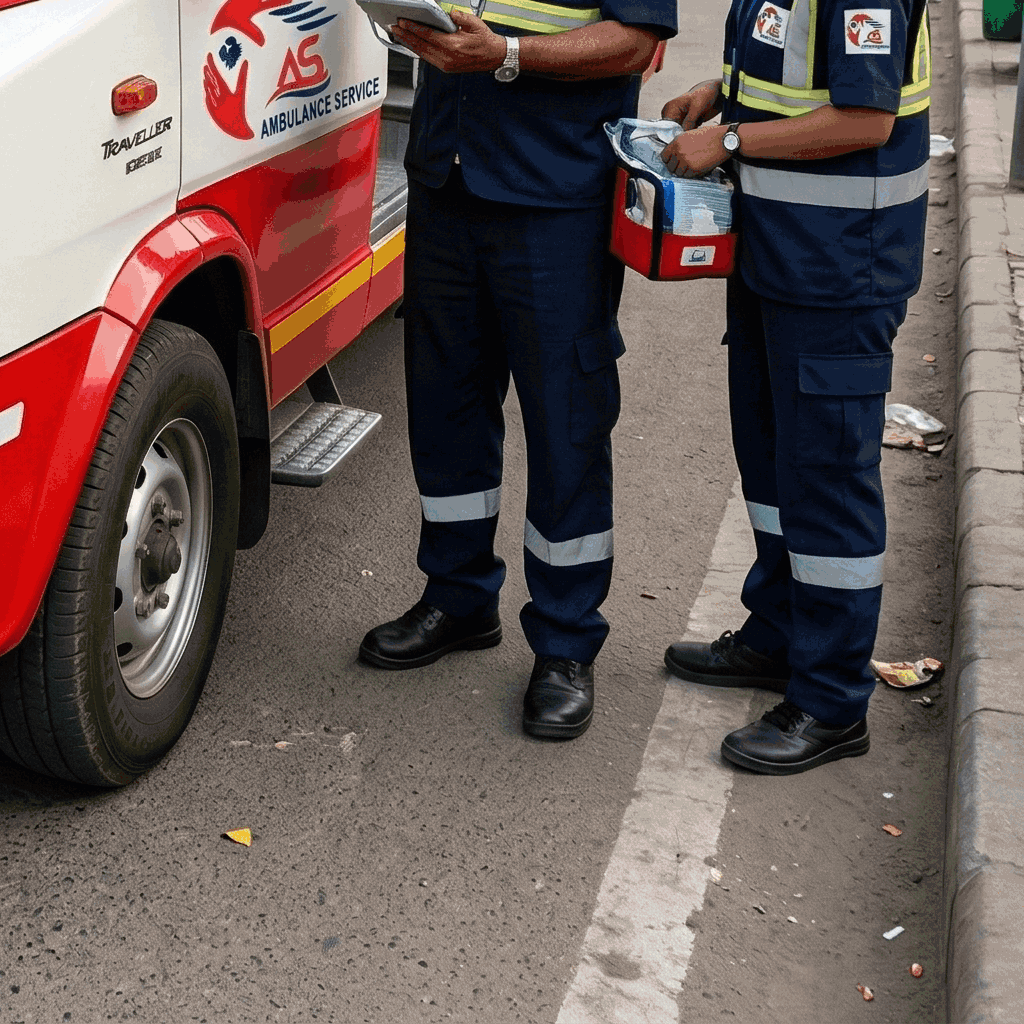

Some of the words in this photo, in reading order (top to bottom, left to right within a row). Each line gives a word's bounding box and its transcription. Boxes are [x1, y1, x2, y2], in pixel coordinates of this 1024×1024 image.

[265, 33, 329, 109] AS
[260, 94, 332, 140] AMBULANCE
[334, 76, 380, 111] SERVICE
